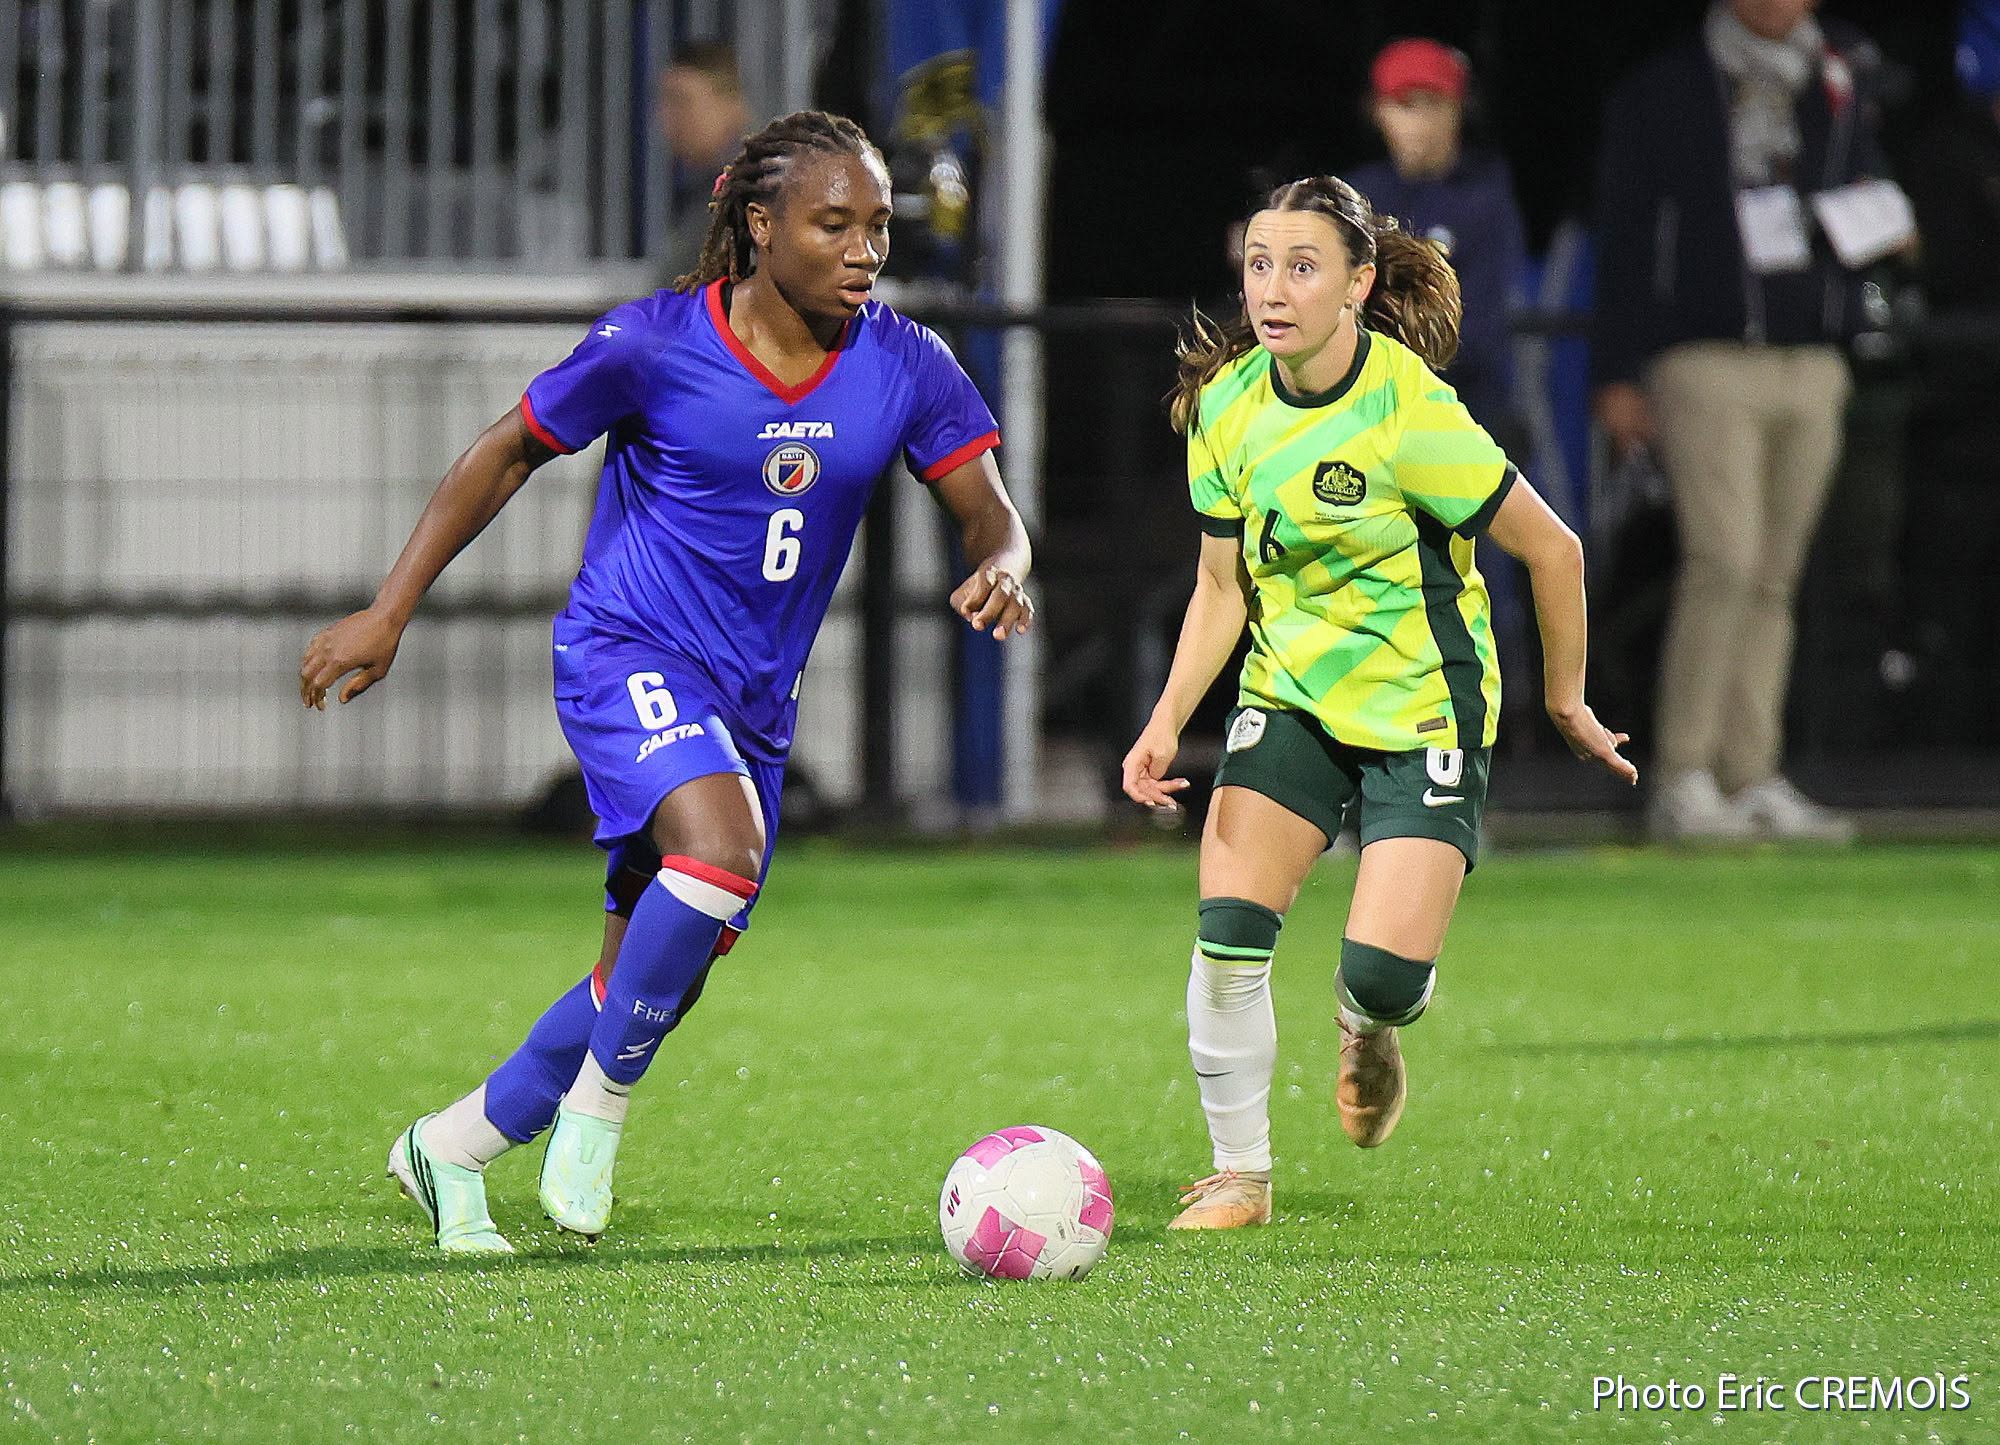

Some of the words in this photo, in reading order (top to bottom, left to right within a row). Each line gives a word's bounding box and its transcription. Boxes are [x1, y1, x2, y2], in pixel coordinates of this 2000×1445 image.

[757, 421, 834, 439] SAETA
[762, 508, 804, 582] 6
[627, 671, 678, 730] 6
[635, 723, 705, 764] SAETA
